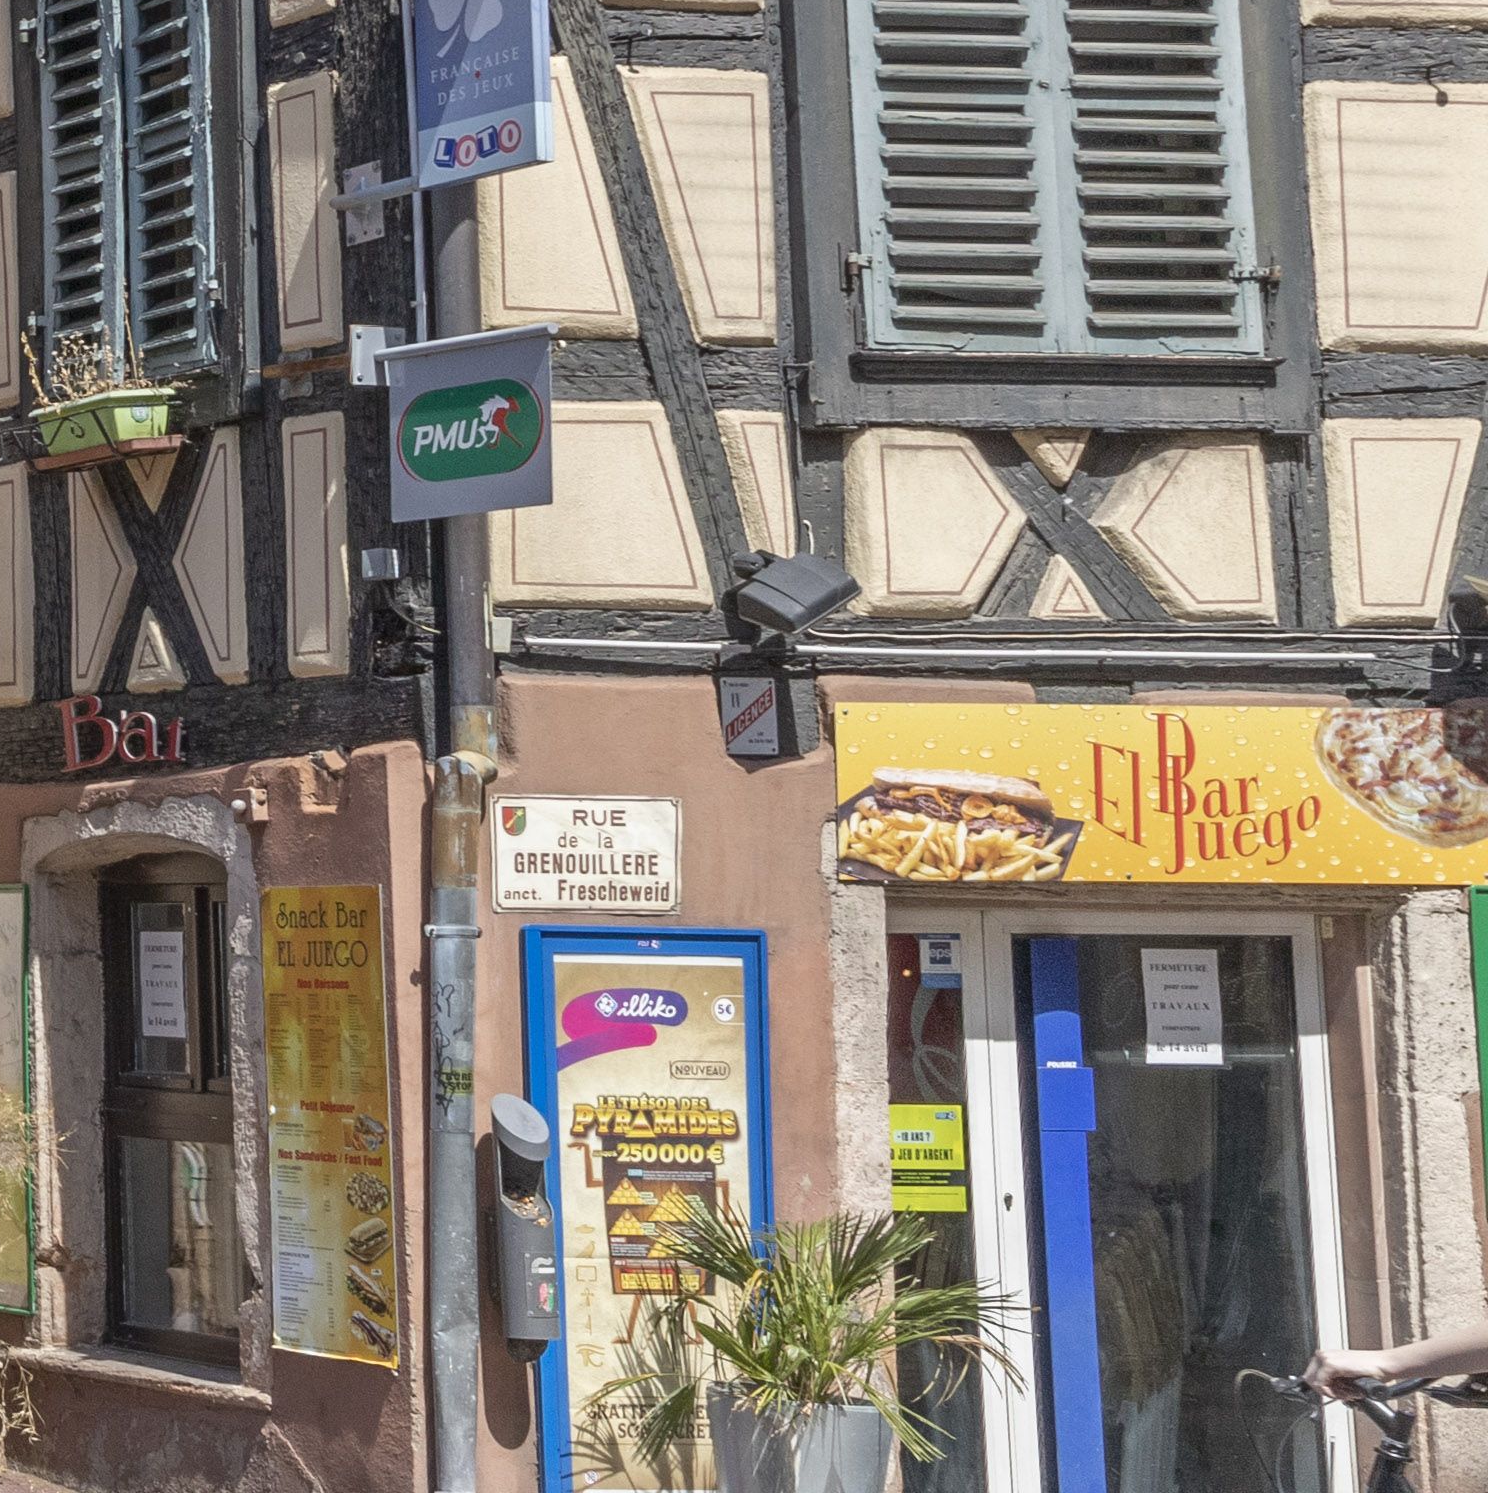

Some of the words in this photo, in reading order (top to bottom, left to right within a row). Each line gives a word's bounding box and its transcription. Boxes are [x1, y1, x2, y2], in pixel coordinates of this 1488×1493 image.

[431, 46, 519, 83] FRANÇAISE
[438, 87, 466, 106] DES
[474, 73, 514, 98] JEUX
[434, 120, 522, 168] LOTO
[413, 418, 478, 456] PMU
[728, 690, 771, 740] LICENCE
[1151, 712, 1260, 818] Bar
[573, 809, 626, 827] RUE
[1086, 740, 1147, 848] El
[1164, 755, 1322, 875] Juego
[557, 832, 578, 848] de
[597, 832, 614, 849] la
[514, 852, 659, 875] GRENOUILLERE
[504, 888, 542, 900] anct.
[557, 879, 670, 902] Frescheweid
[276, 901, 328, 929] Snack
[336, 902, 367, 928] Bar
[277, 941, 295, 967] EL
[304, 940, 368, 967] JUEGO
[1150, 964, 1207, 972] FERMETURE
[297, 978, 313, 989] Nos
[314, 979, 349, 989] Boissons
[616, 992, 677, 1018] illiko
[717, 1003, 732, 1015] 5€
[1152, 1002, 1210, 1010] TRAVAUX
[1184, 1042, 1208, 1052] avril
[674, 1065, 727, 1076] NOUVEAU
[300, 1100, 317, 1111] Petit
[598, 1095, 616, 1109] LE
[621, 1093, 677, 1110] TRÉSOR
[679, 1097, 708, 1110] DES
[571, 1104, 738, 1137] PYRAMIDES
[278, 1149, 293, 1160] Nos
[345, 1153, 361, 1165] Fast
[363, 1155, 383, 1166] Food
[898, 1148, 912, 1160] JEU
[915, 1148, 953, 1160] D'ARGENT
